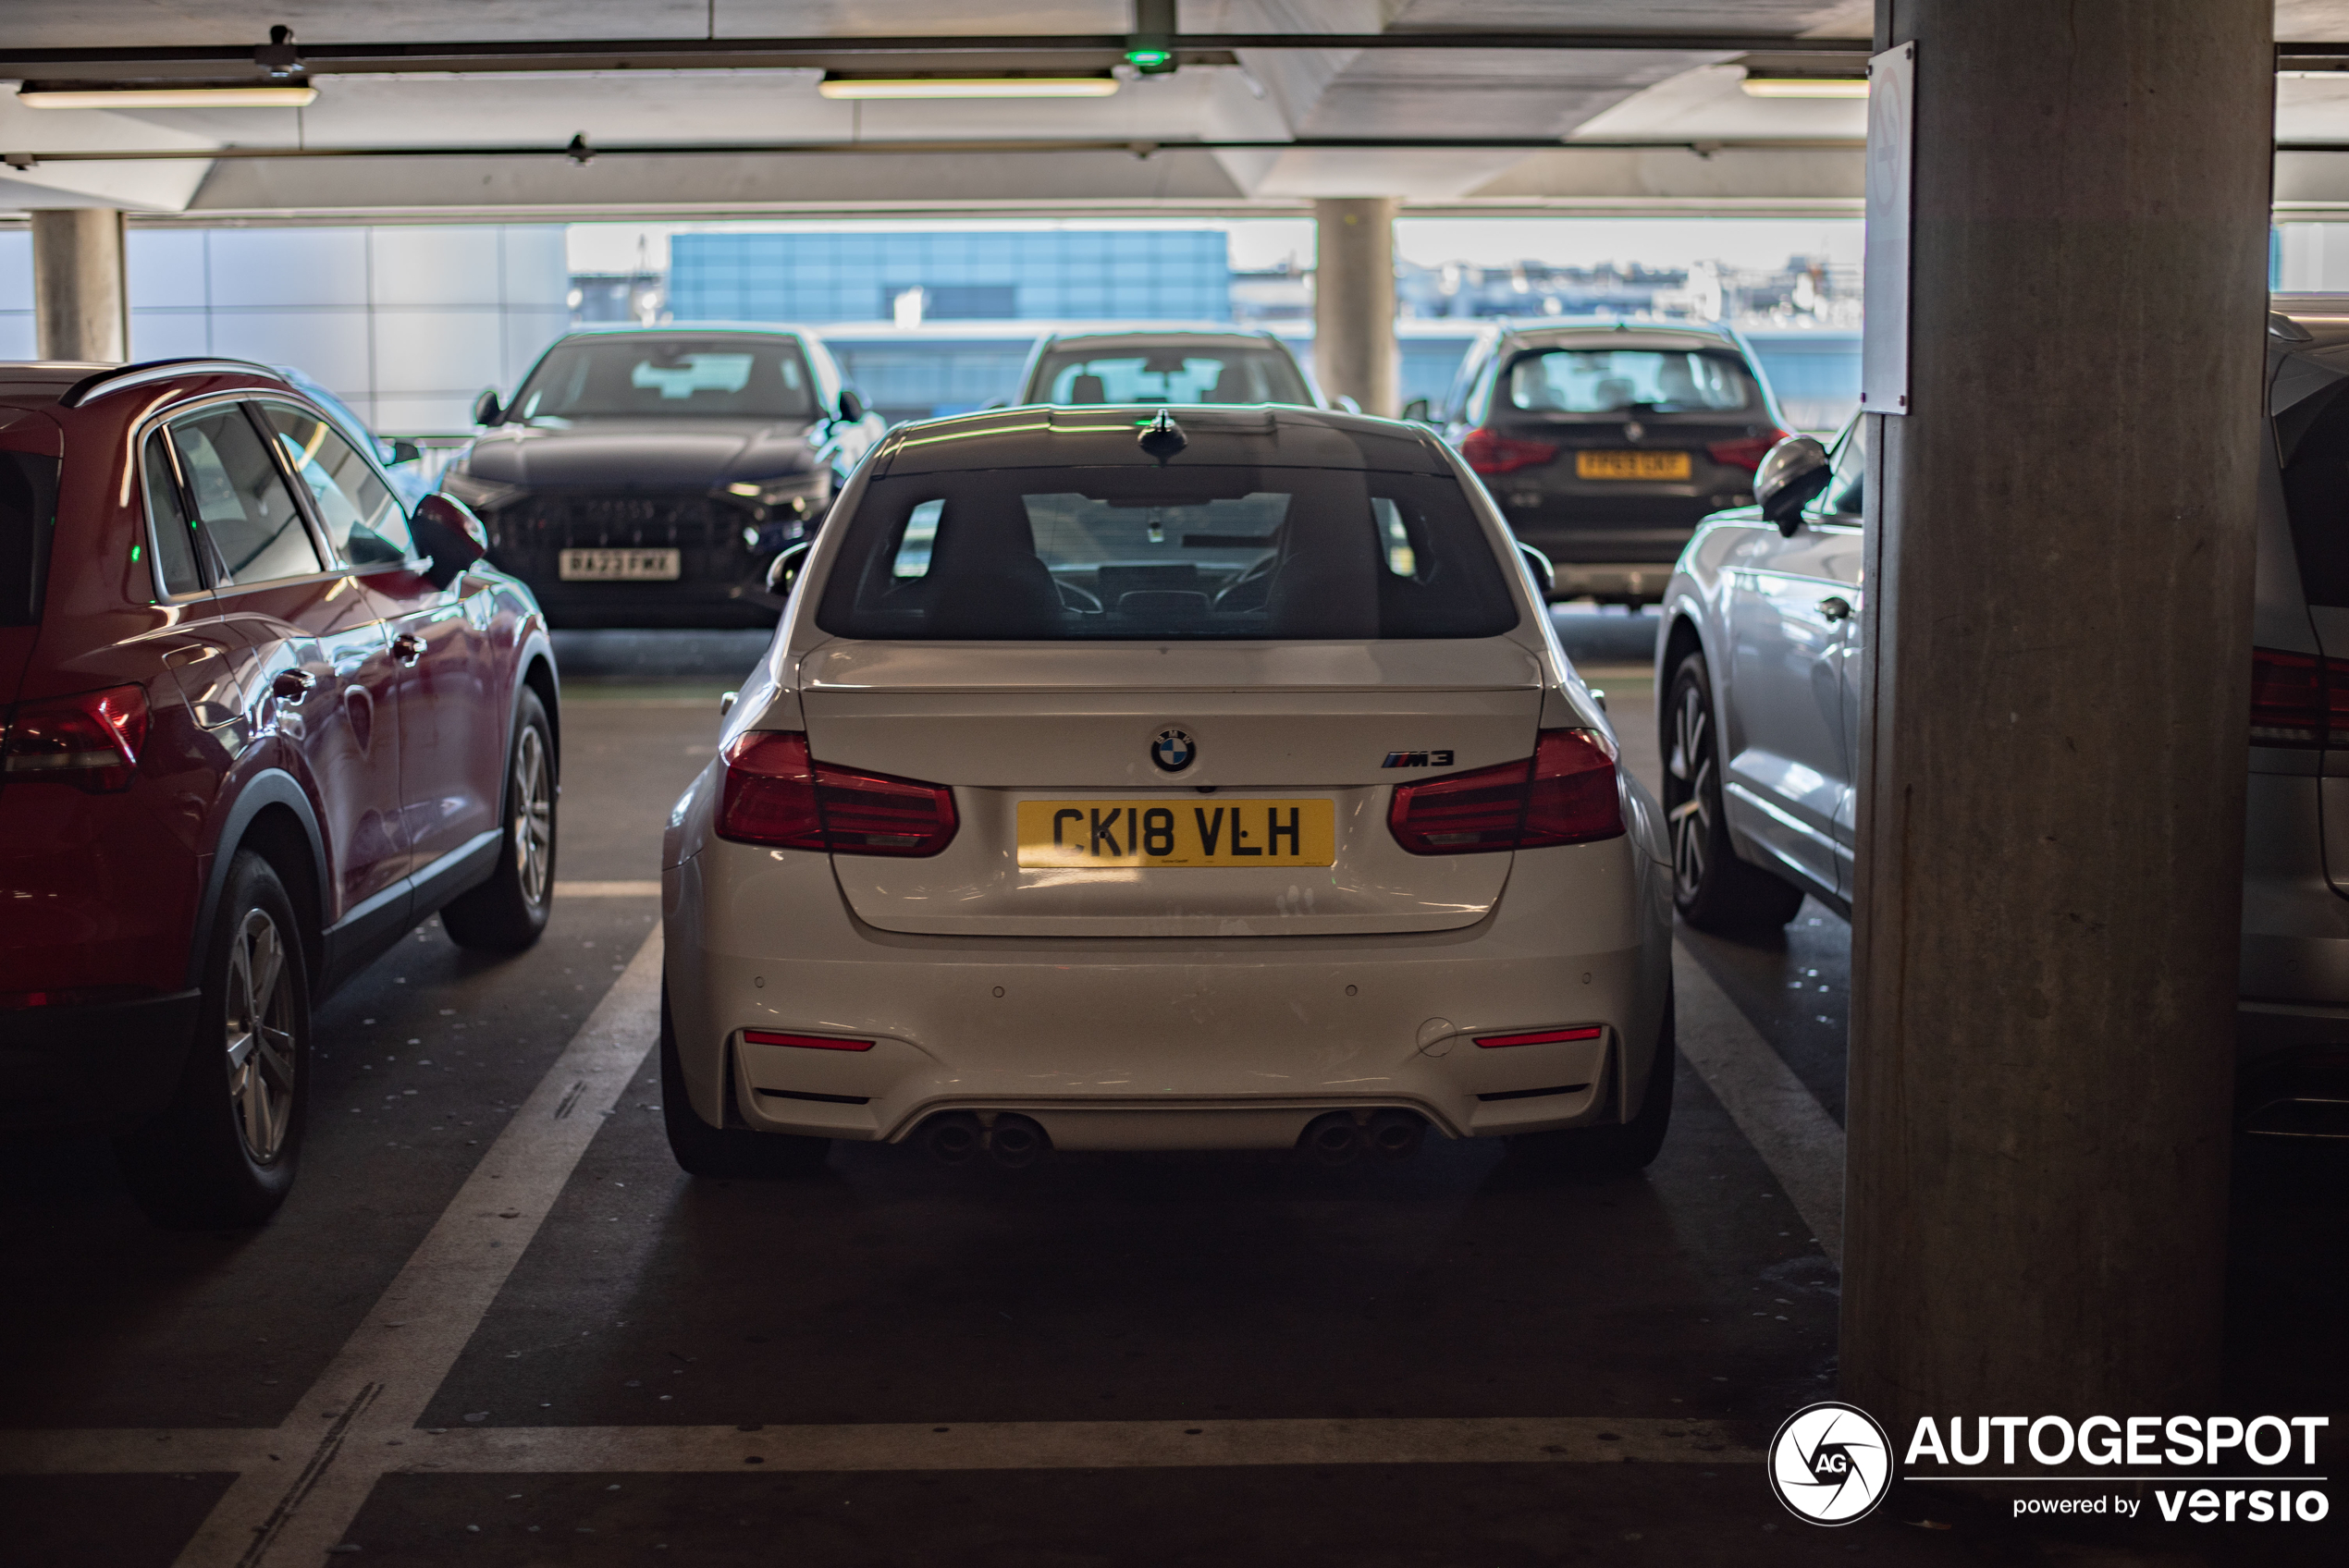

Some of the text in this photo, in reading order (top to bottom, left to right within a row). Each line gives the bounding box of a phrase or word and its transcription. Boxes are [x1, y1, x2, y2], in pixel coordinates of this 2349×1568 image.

[1156, 729, 1192, 744] BMW
[1391, 750, 1454, 767] M3
[1053, 807, 1299, 857] CK18 VLH
